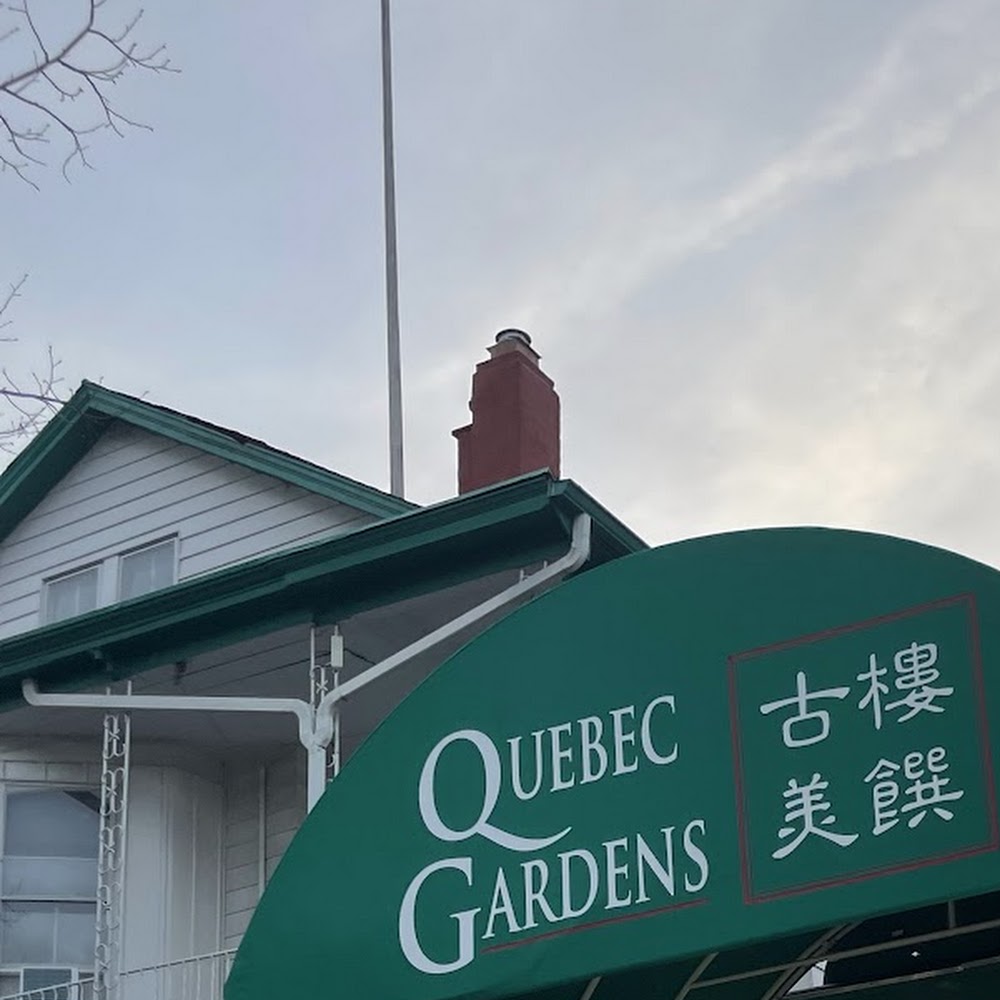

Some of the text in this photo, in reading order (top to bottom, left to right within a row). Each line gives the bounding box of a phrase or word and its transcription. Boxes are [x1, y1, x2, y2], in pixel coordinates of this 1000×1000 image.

[760, 642, 954, 748] 古樓
[419, 695, 677, 851] QUEBEC
[399, 819, 710, 974] GARDENS
